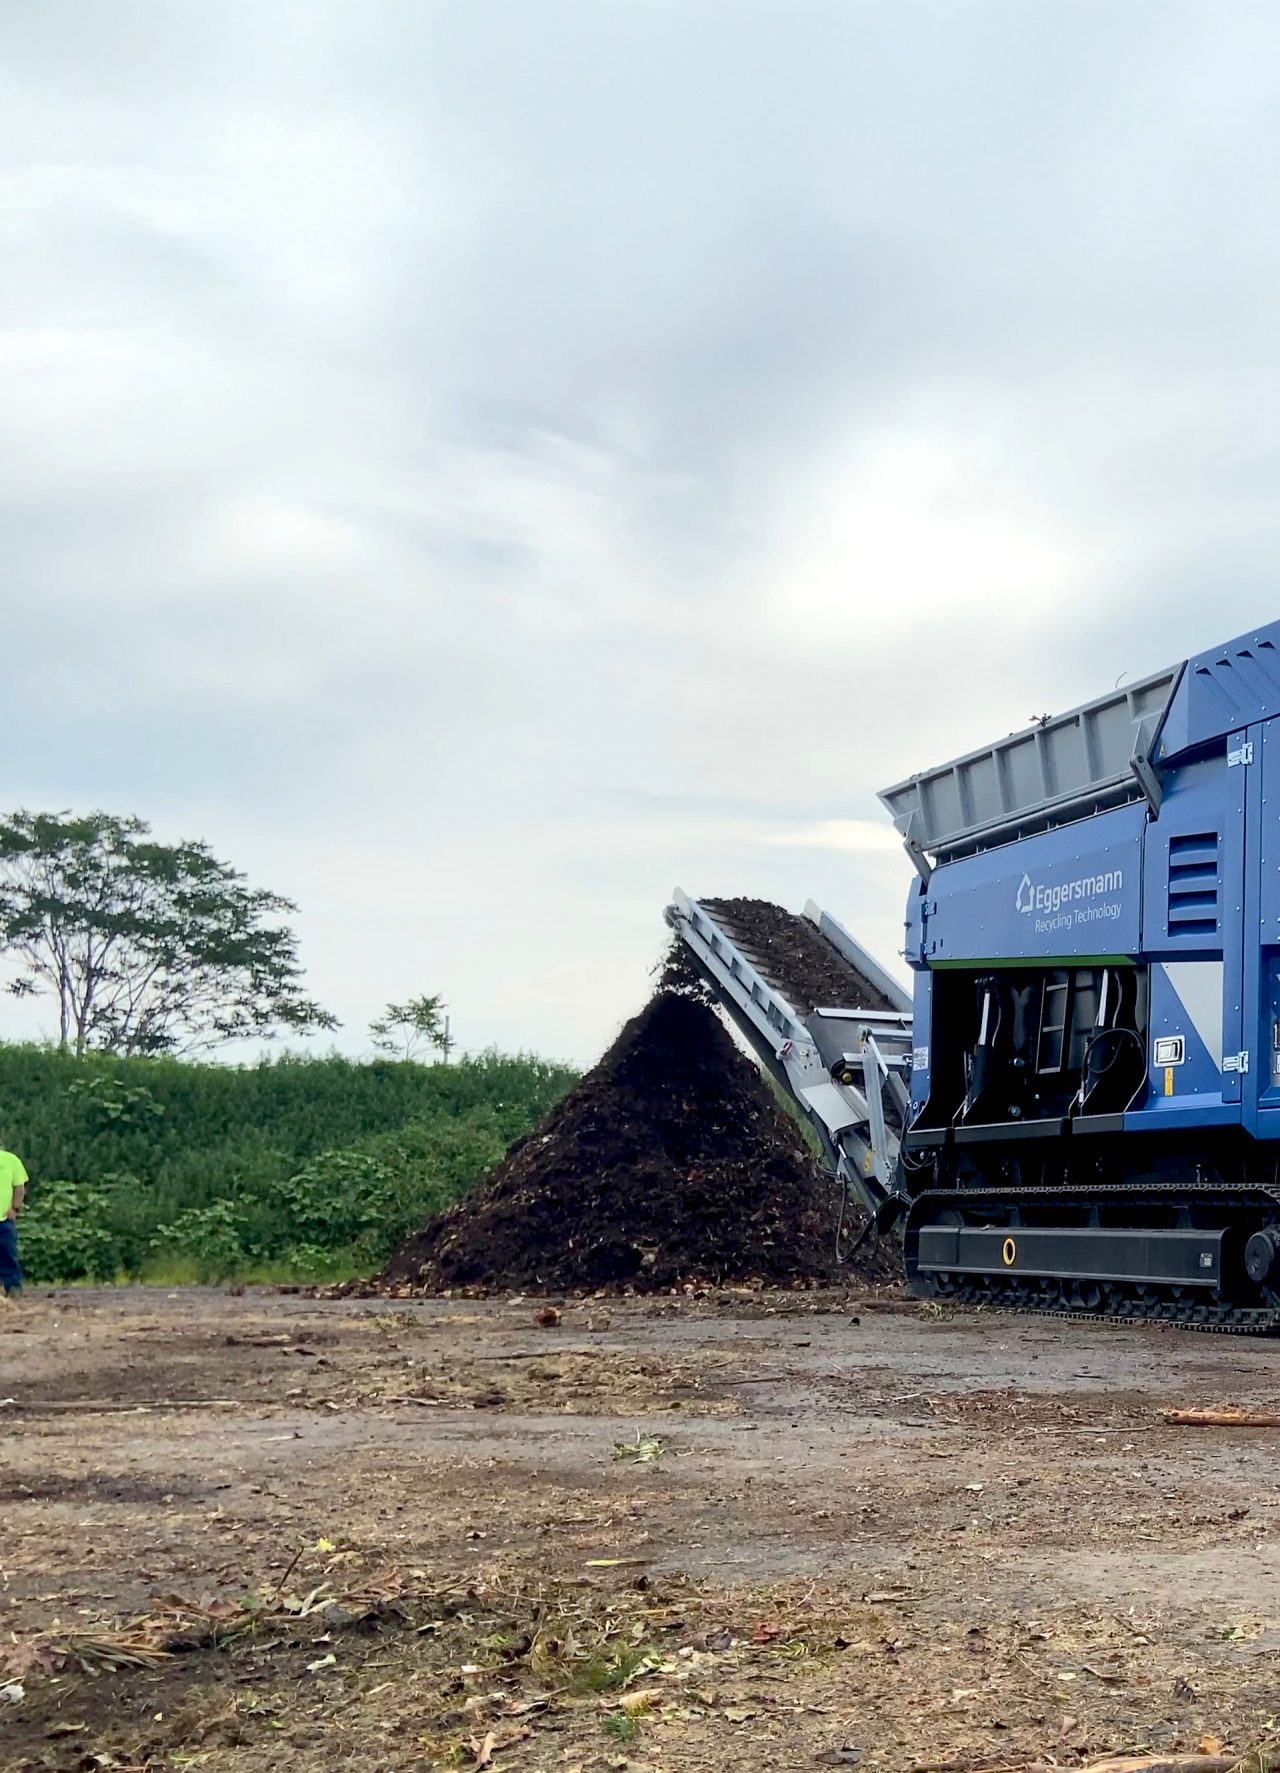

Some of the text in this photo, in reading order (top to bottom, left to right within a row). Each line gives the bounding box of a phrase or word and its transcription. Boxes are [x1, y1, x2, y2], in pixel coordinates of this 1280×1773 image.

[1035, 869, 1123, 914] Eggersmann
[1035, 902, 1122, 935] Recycling Technology
